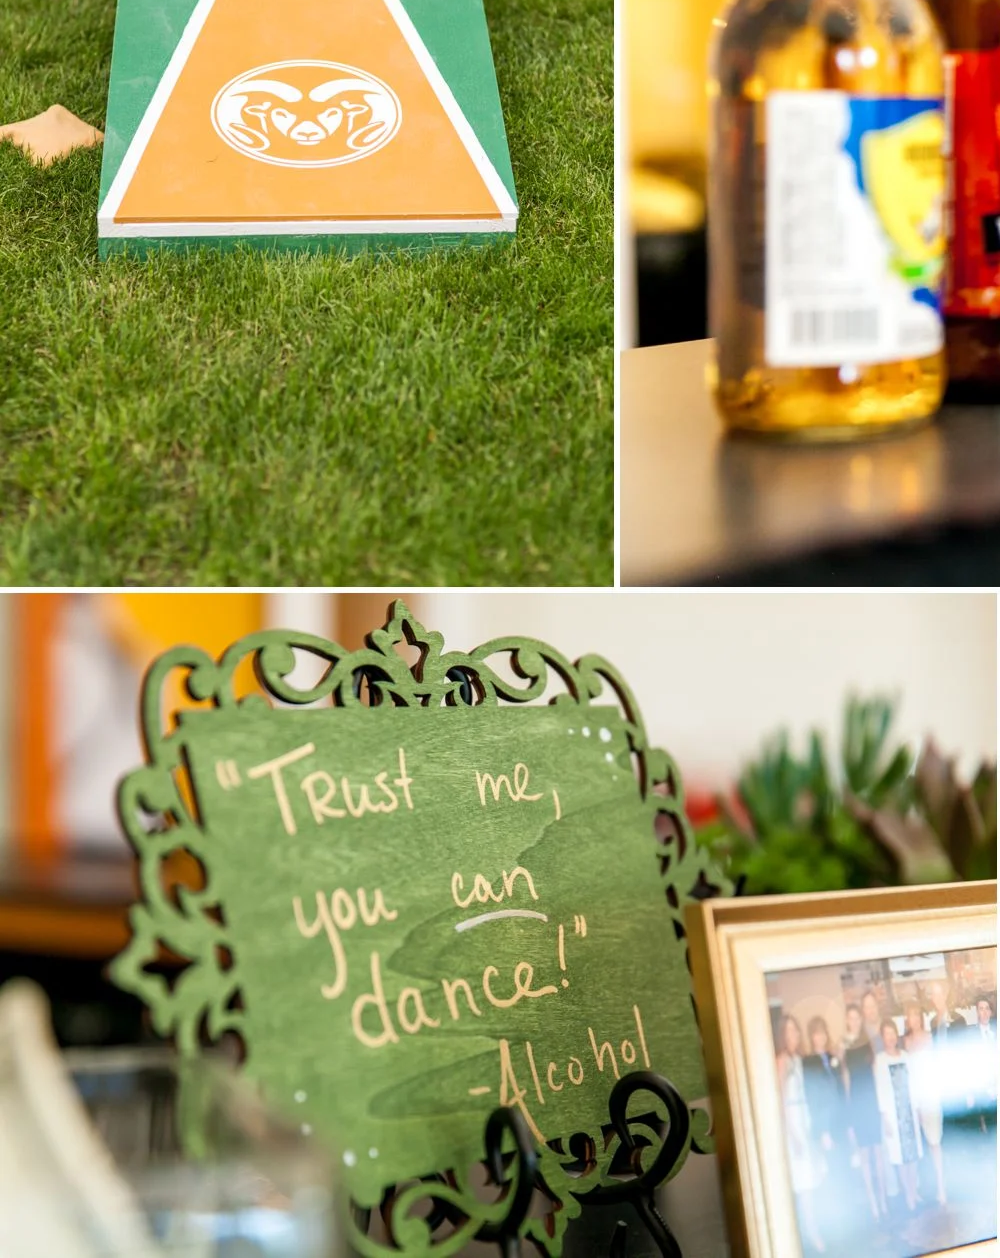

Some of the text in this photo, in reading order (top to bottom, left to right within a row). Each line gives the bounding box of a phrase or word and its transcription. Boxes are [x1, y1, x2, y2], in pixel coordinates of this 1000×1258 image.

[475, 762, 562, 820] me,
[293, 865, 539, 1000] you can
